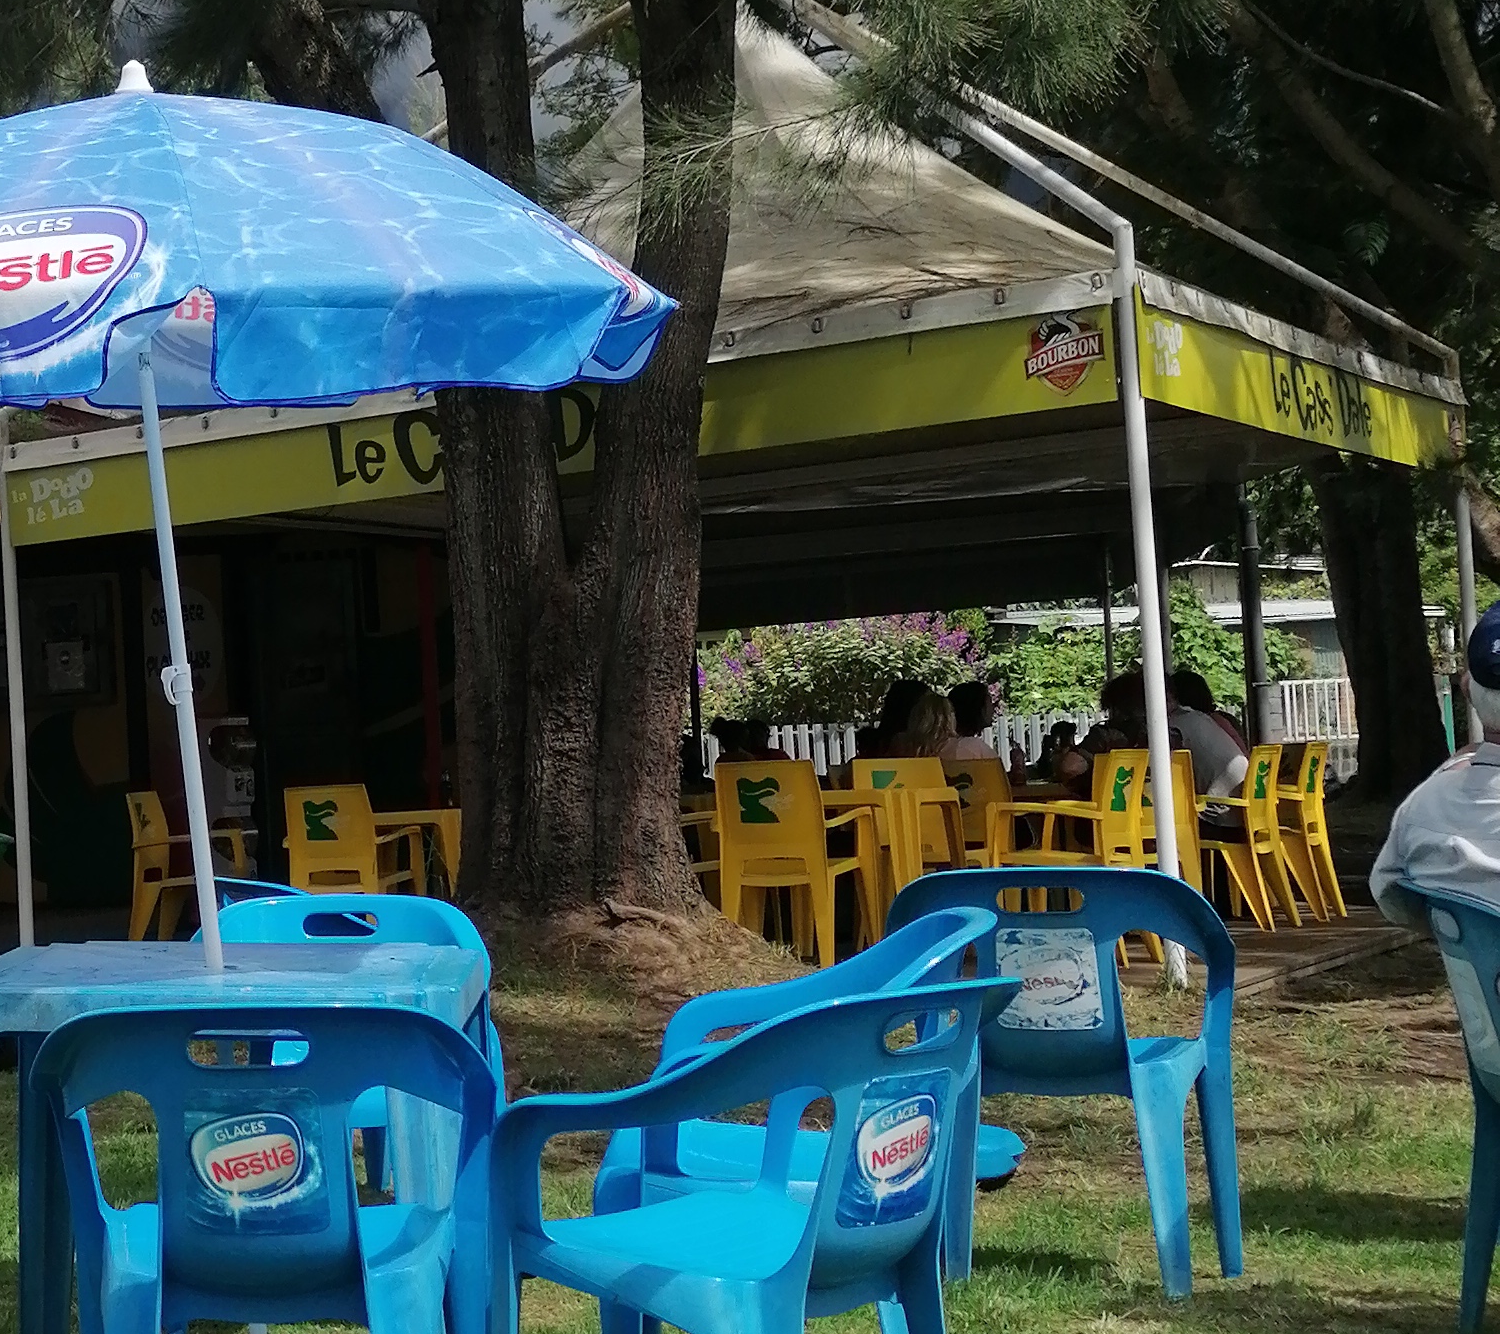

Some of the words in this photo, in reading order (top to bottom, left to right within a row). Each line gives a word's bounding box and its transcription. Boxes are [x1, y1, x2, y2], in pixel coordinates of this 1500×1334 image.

[1027, 335, 1100, 375] BOURBON
[1269, 346, 1291, 417] Le
[1335, 369, 1373, 438] Dale
[327, 424, 386, 487] Le
[214, 1120, 267, 1142] GLACES
[881, 1103, 920, 1128] GLACES
[211, 1142, 295, 1183] Nestlé
